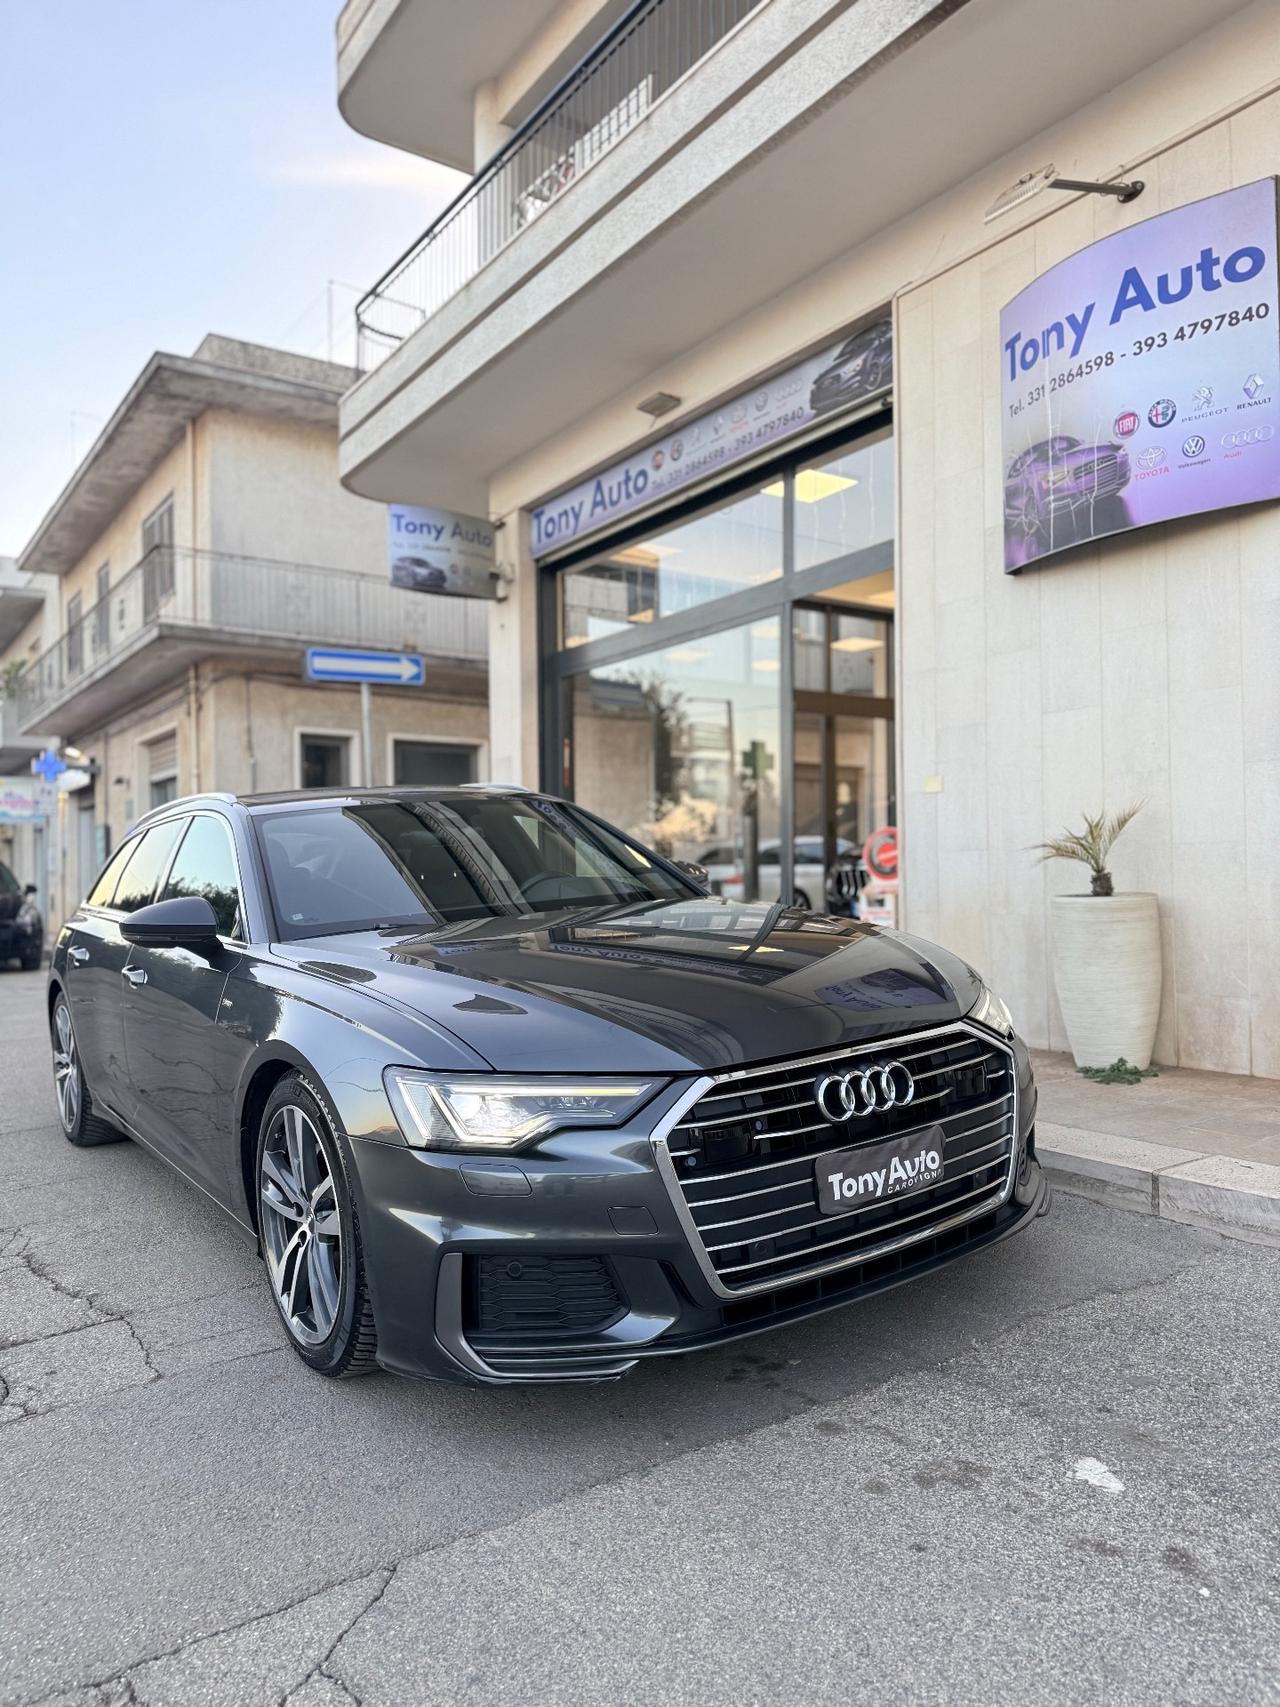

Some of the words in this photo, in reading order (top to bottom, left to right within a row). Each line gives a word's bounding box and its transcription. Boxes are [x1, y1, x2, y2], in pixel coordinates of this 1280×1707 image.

[1004, 301, 1096, 382] Tony
[1108, 246, 1266, 326] Auto
[1009, 398, 1025, 418] Tel.
[1027, 384, 1046, 406] 331
[1049, 351, 1115, 393] 2864598
[1132, 332, 1168, 357] 393
[1174, 302, 1270, 343] 4797840
[1181, 407, 1229, 423] PEUGEOT
[1237, 397, 1272, 410] RENAULT
[1135, 466, 1170, 481] TOYOTA
[533, 501, 584, 544] Tony
[590, 467, 648, 517] Auto
[392, 513, 445, 541] Tony
